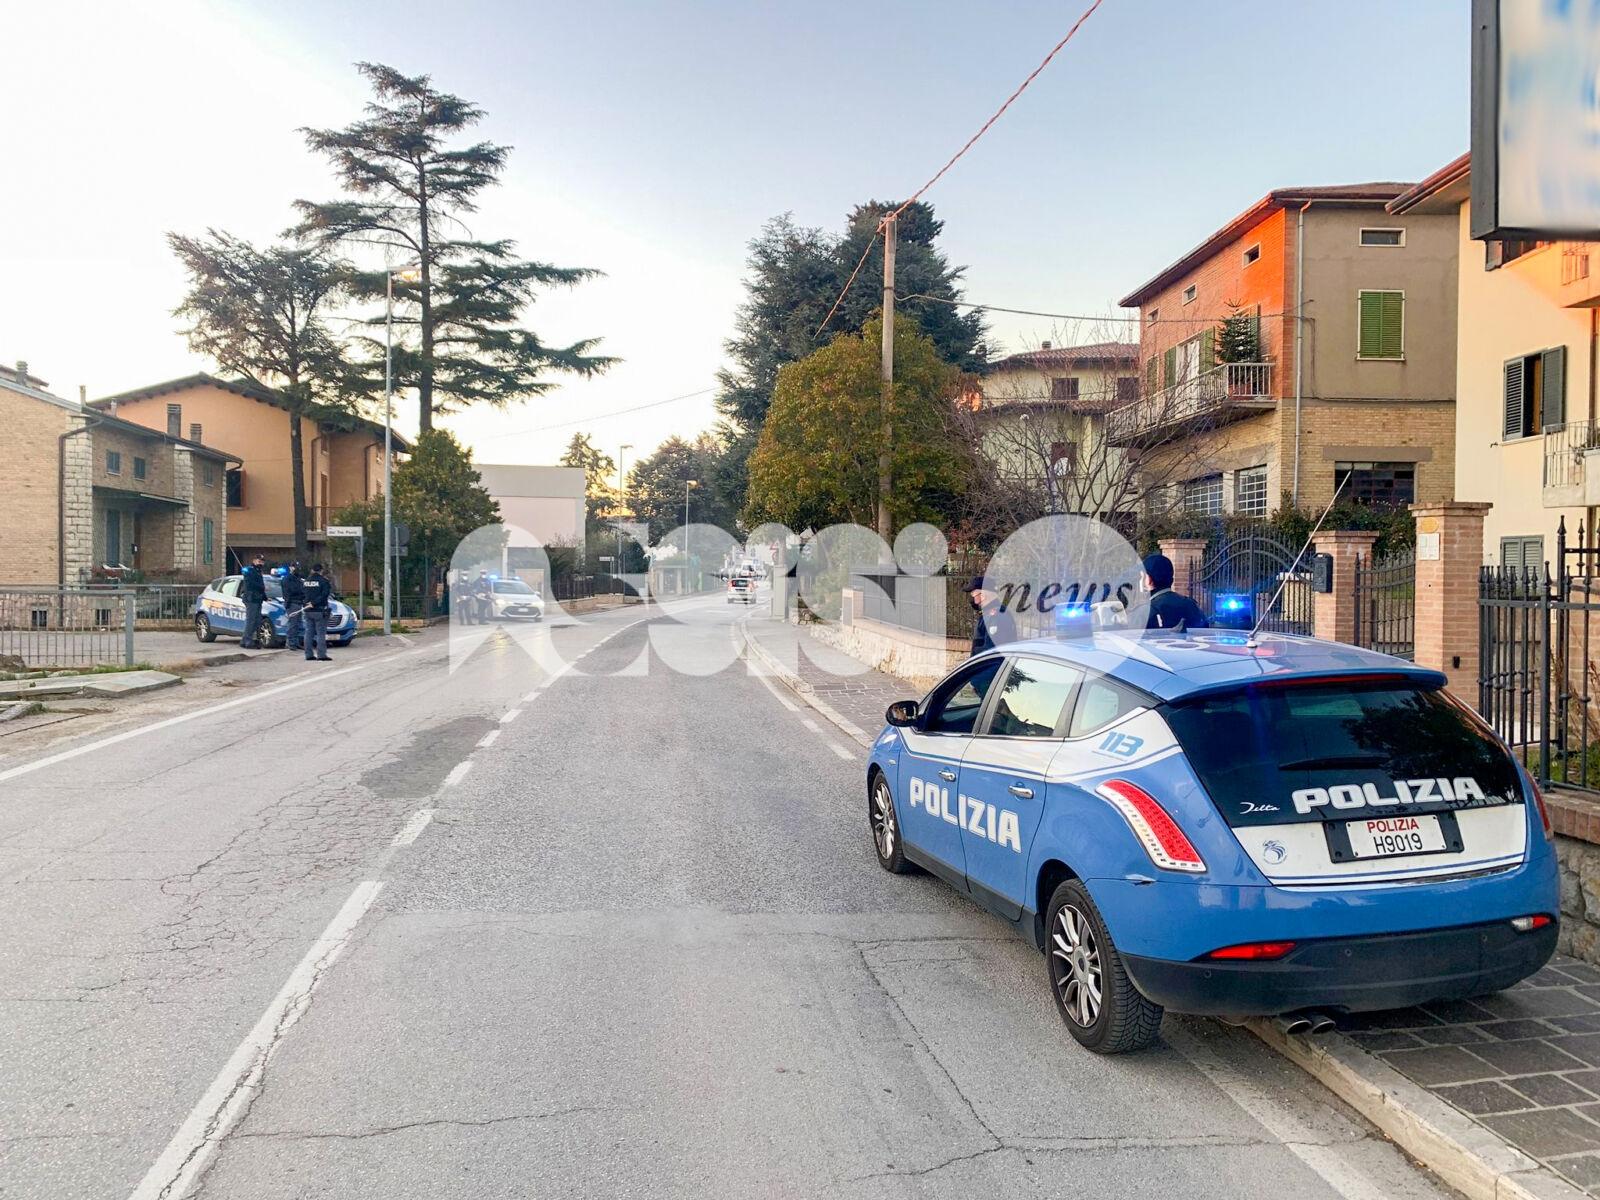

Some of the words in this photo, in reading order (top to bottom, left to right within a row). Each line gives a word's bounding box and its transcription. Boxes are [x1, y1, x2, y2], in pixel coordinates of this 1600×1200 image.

[1098, 731, 1145, 757] 113
[1291, 776, 1486, 814] POLIZIA
[909, 776, 1022, 854] POLIZIA
[1239, 801, 1281, 815] Delta
[1367, 817, 1420, 834] POLIZIA
[1373, 832, 1424, 855] H9019
